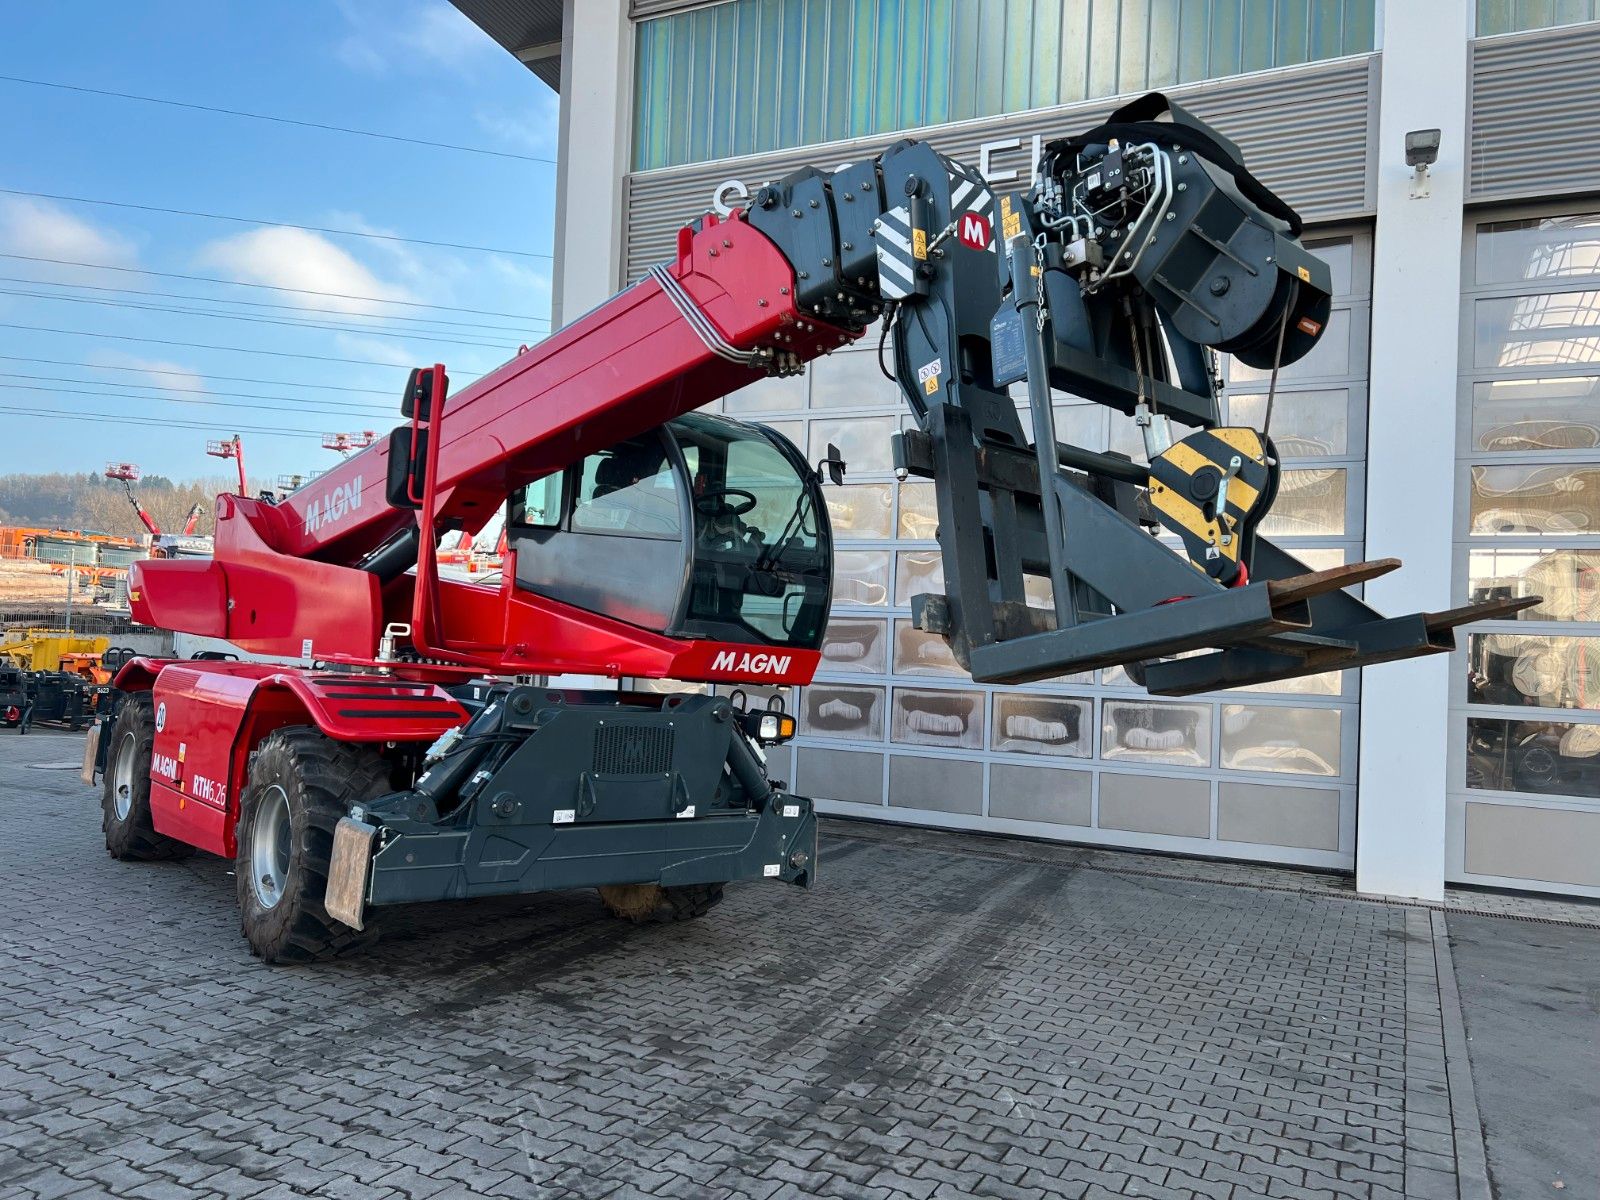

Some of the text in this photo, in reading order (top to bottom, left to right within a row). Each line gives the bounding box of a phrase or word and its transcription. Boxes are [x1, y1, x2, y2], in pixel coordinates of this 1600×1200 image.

[964, 215, 985, 247] M
[304, 474, 362, 536] MAGNI
[710, 650, 792, 675] MAGNI
[152, 752, 177, 780] MAGNI
[192, 774, 227, 806] RTH6.26
